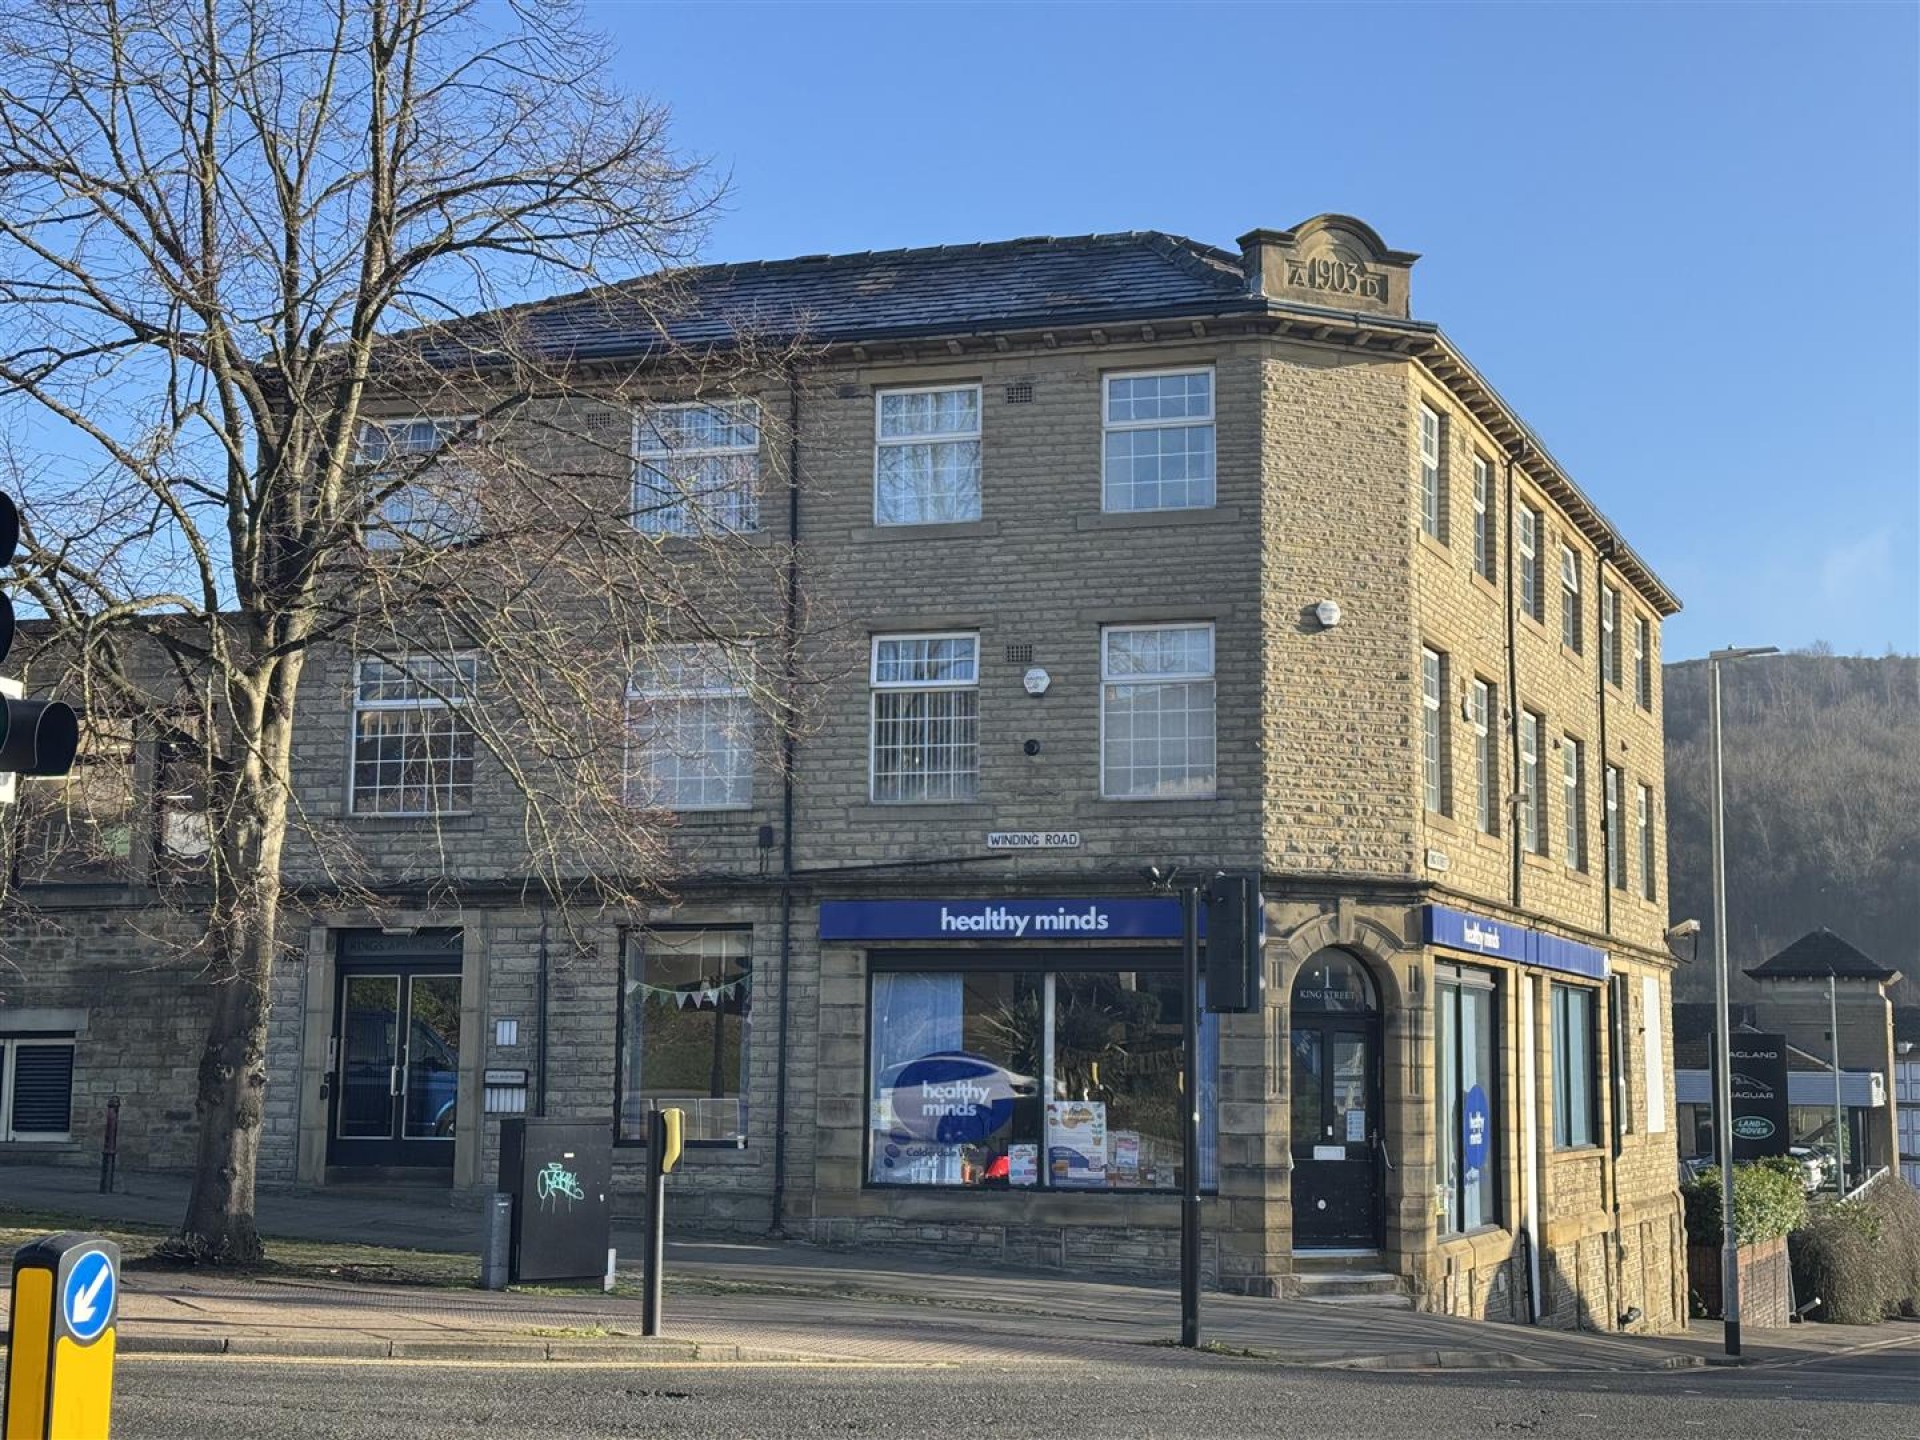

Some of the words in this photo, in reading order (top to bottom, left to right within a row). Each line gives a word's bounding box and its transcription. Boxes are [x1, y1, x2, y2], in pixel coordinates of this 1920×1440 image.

[1314, 257, 1358, 294] 1903
[990, 834, 1040, 845] WINDING
[1045, 834, 1077, 845] ROAD
[941, 906, 1031, 937] healthy
[1035, 906, 1109, 930] minds
[1324, 965, 1333, 989] 1
[1300, 989, 1322, 999] KING
[1324, 991, 1355, 1000] STREET
[1729, 1051, 1778, 1059] AGLAND
[922, 1079, 990, 1104] healthy
[922, 1098, 977, 1117] minds
